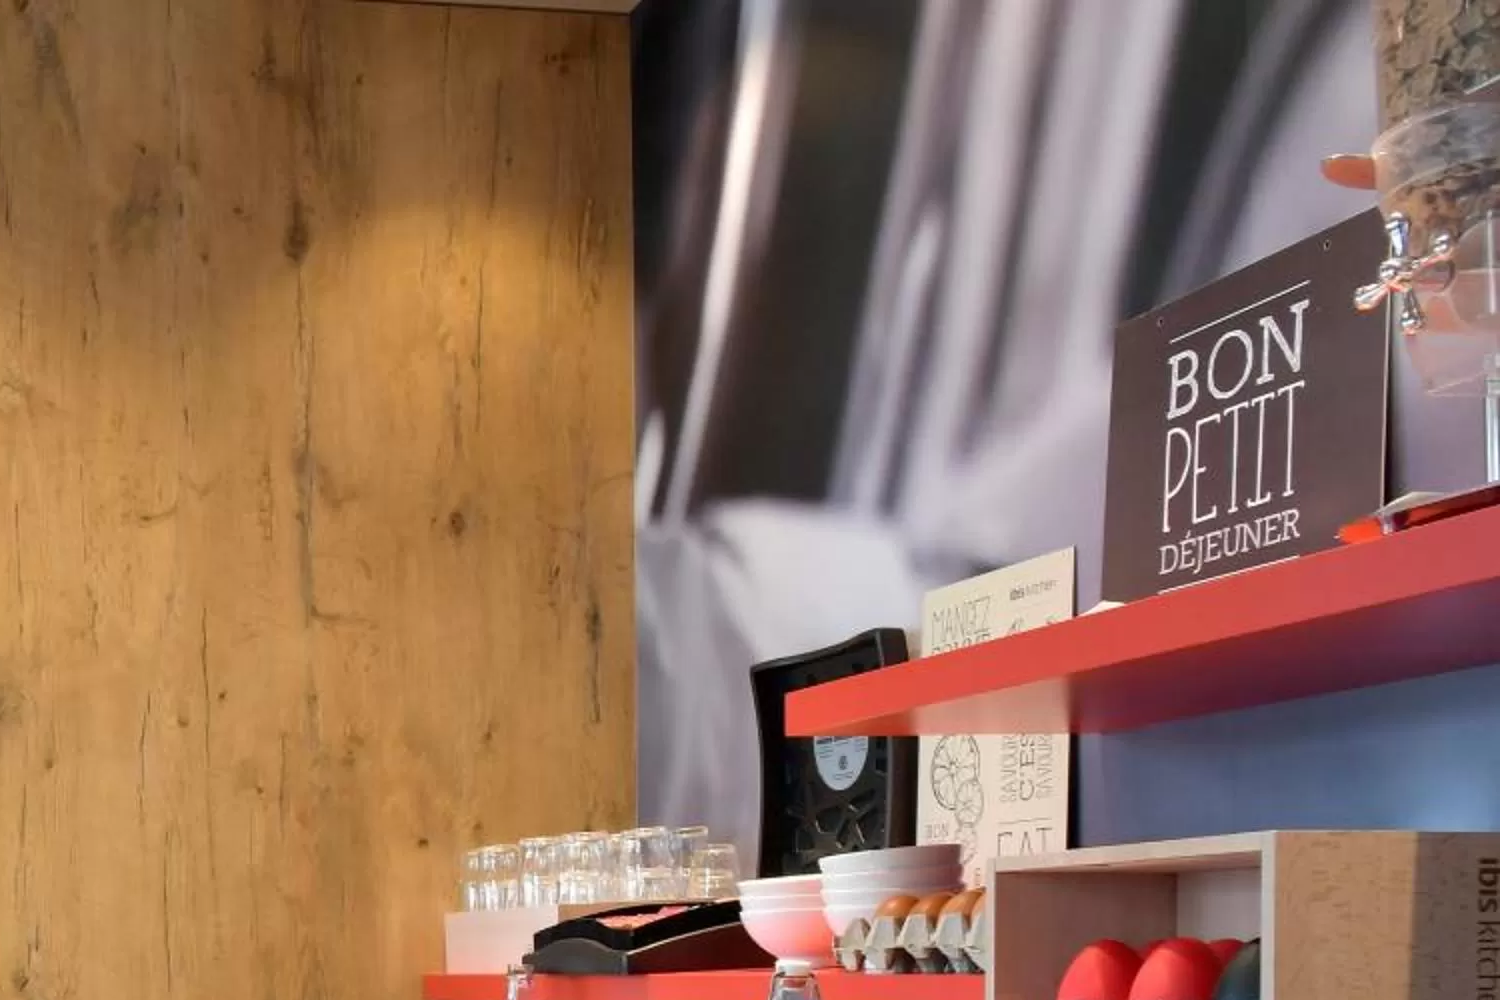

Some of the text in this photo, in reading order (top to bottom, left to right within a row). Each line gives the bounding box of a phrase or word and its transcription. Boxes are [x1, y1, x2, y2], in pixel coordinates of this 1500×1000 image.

[1167, 299, 1310, 420] BON
[1162, 381, 1305, 533] PETIT
[1158, 508, 1300, 575] DÉJEUNER
[1477, 857, 1500, 913] ibis
